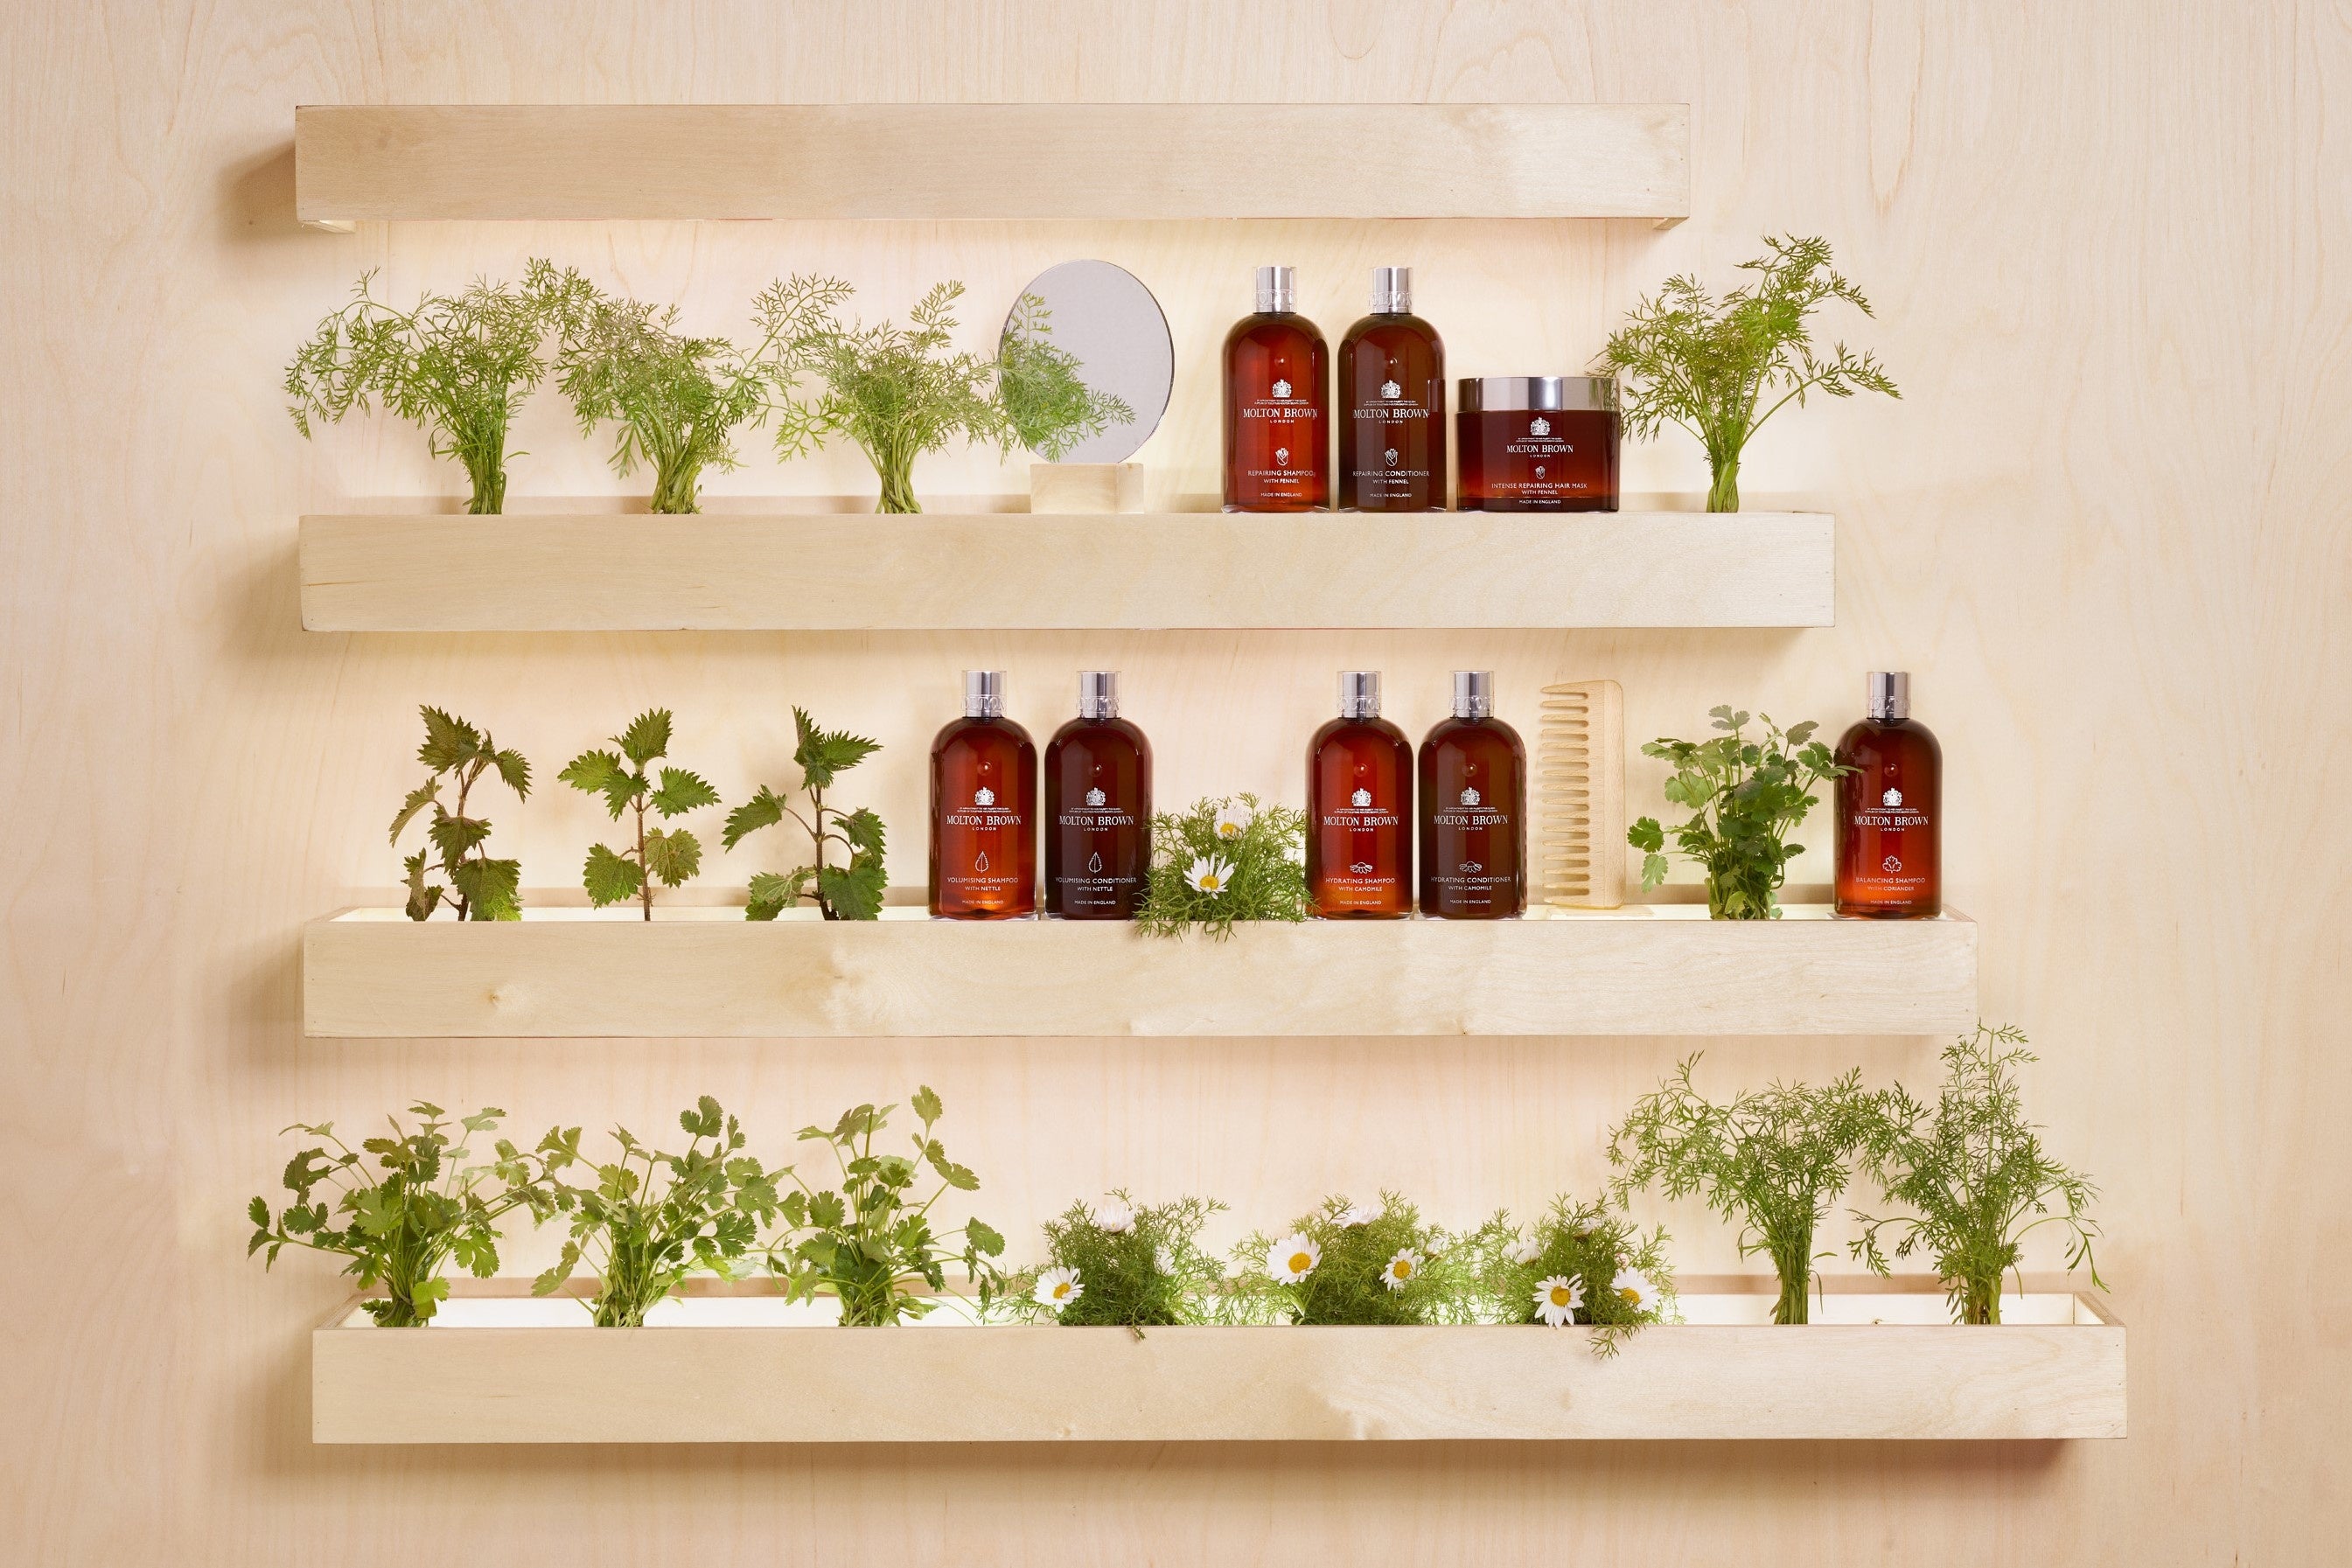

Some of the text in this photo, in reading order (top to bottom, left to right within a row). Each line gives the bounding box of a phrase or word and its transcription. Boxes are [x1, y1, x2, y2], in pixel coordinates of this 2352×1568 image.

[1243, 408, 1318, 418] MOLTON BROWN
[1353, 408, 1429, 419] MOLTON BROWN
[1506, 444, 1574, 453] MOLTON BROWN
[946, 815, 1022, 825] MOLTON BROWN
[1059, 816, 1134, 826] MOLTON BROWN
[1323, 816, 1399, 826] MOLTON BROWN
[1434, 815, 1508, 825] MOLTON BROWN
[1854, 816, 1929, 826] MOLTON BROWN
